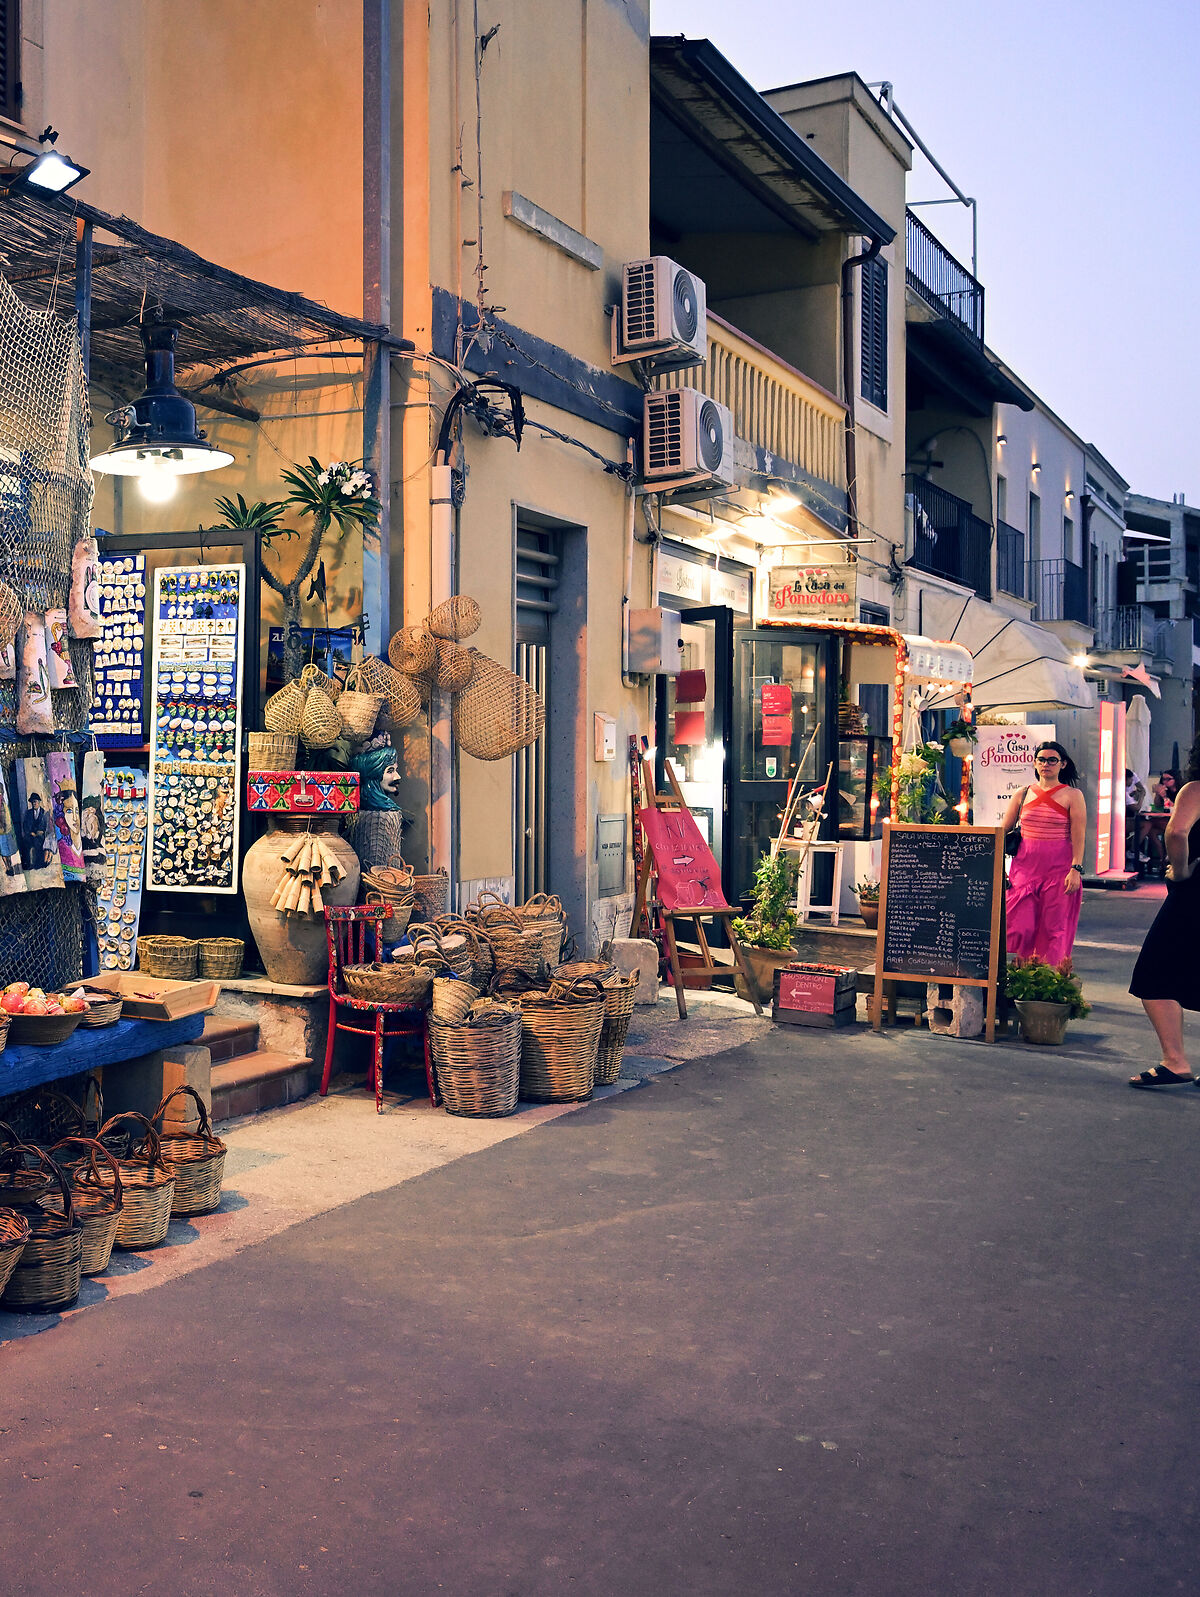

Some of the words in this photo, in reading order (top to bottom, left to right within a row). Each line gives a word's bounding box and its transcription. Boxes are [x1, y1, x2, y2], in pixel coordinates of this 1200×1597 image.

[793, 580, 802, 592] La
[805, 577, 831, 593] Casa
[834, 581, 845, 590] del
[774, 585, 849, 609] Pomodoro
[997, 743, 1004, 753] La
[1007, 740, 1029, 754] Casa
[981, 746, 1034, 767] Pomodo
[896, 832, 916, 841] SALA
[886, 956, 904, 964] ARIA
[795, 980, 822, 990] DENTRO
